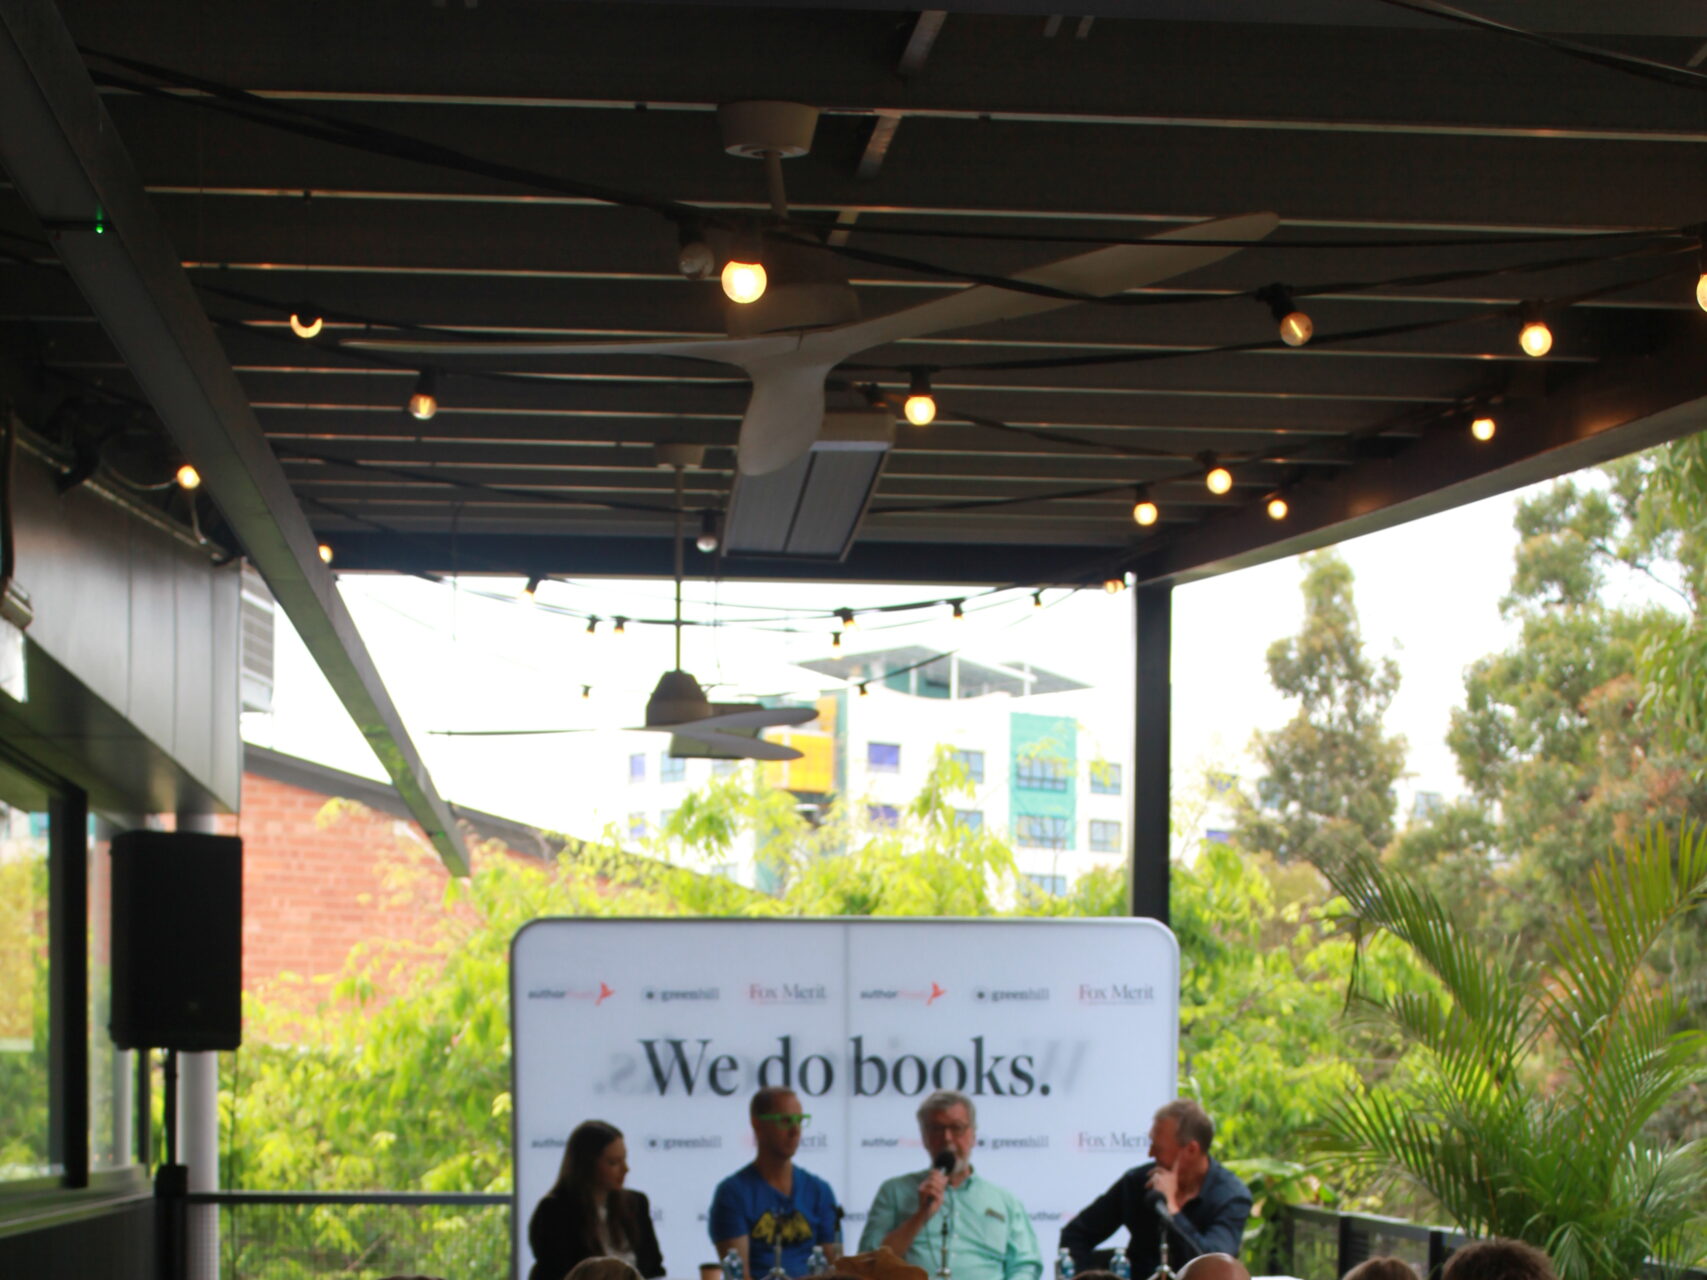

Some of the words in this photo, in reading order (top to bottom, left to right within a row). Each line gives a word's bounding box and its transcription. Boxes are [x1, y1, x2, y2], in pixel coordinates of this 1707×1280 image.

[749, 984, 776, 999] Fox
[782, 984, 826, 999] Merit
[1079, 984, 1106, 999] Fox
[1111, 984, 1154, 999] Merit
[637, 1039, 740, 1096] We
[757, 1035, 834, 1096] do
[850, 1035, 1051, 1097] books.
[1078, 1132, 1104, 1147] Fox
